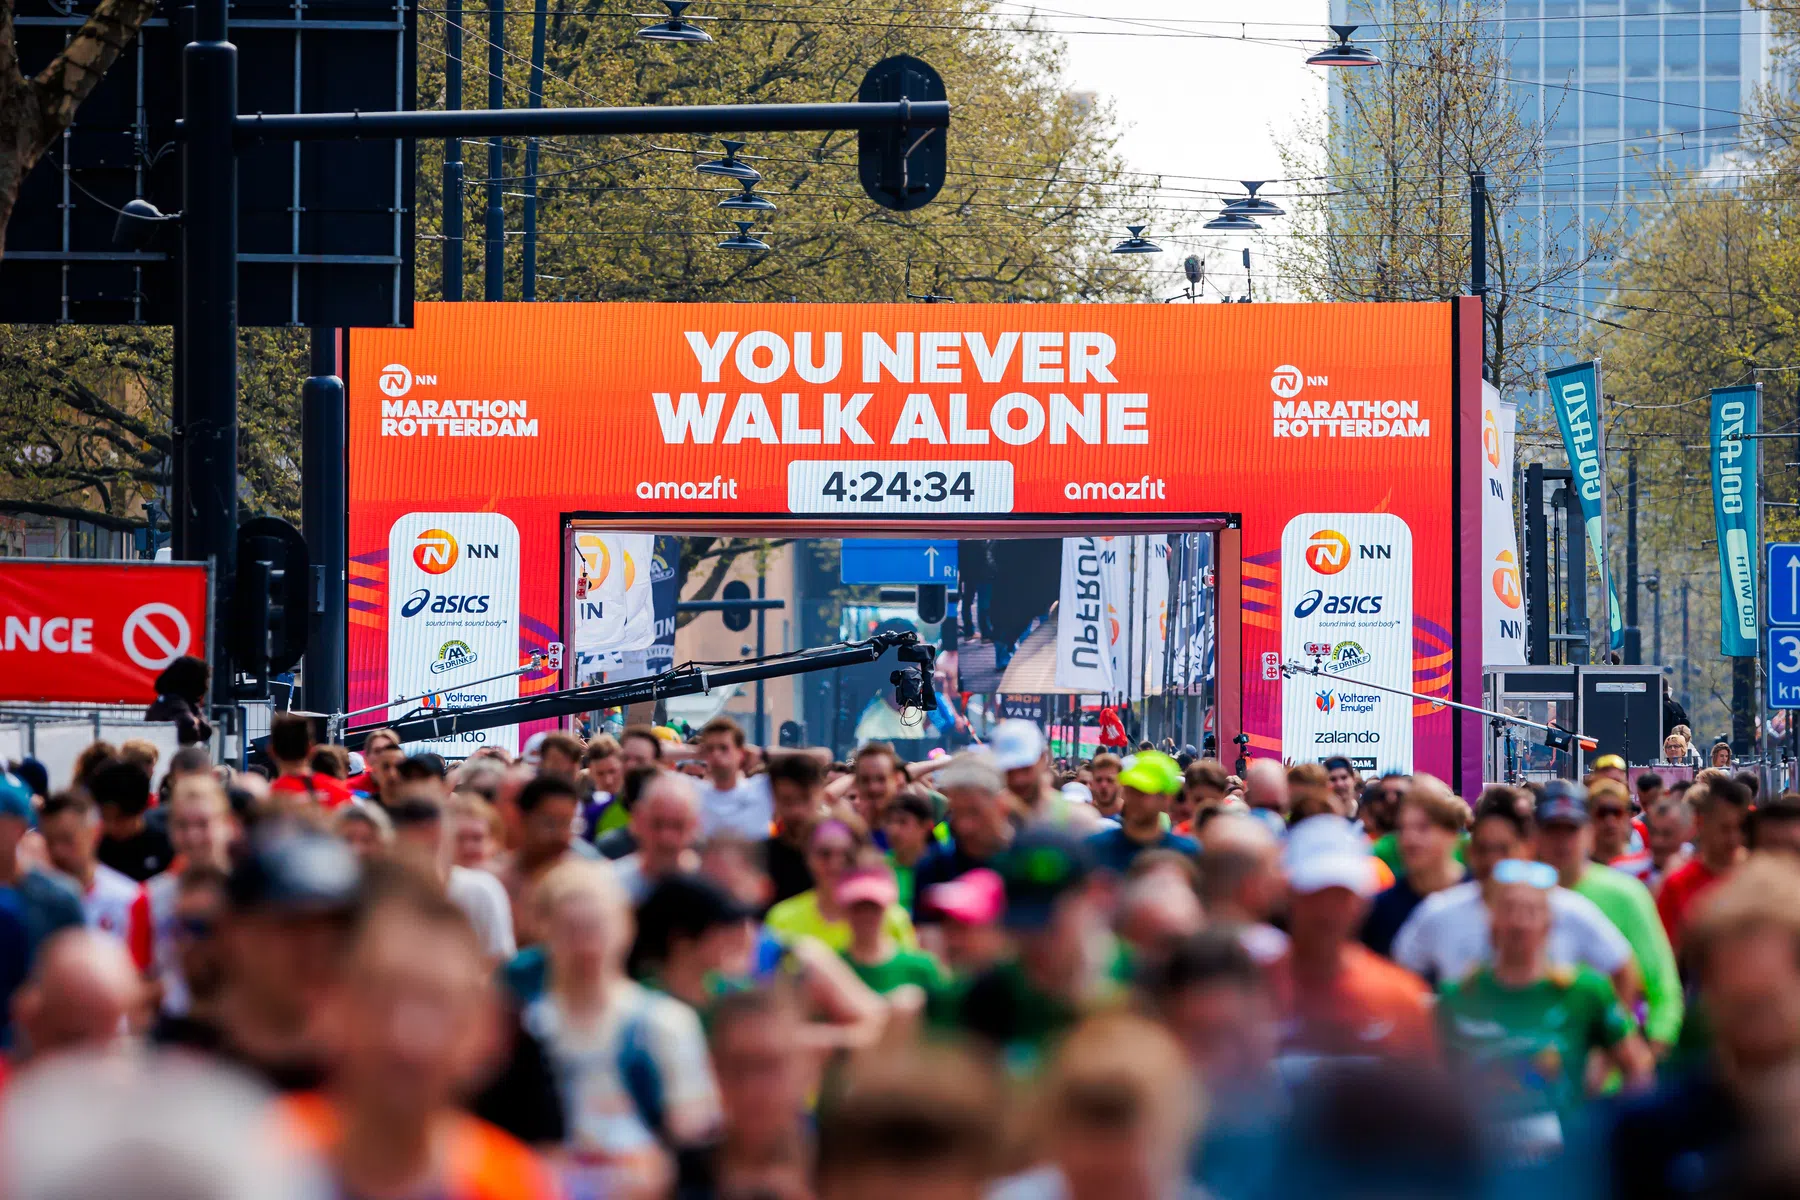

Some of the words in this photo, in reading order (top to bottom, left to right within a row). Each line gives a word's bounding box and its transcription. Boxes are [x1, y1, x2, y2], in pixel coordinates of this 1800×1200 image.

[684, 331, 842, 383] YOU
[863, 332, 1118, 383] NEVER
[415, 375, 437, 386] NN
[1307, 376, 1329, 386] NN
[381, 400, 527, 418] MARATHON
[1273, 401, 1419, 419] MARATHON
[652, 392, 874, 444] WALK
[890, 393, 1149, 445] ALONE
[381, 418, 539, 437] ROTTERDAM
[1273, 419, 1431, 437] ROTTERDAM
[636, 475, 738, 500] amazfit
[822, 470, 975, 502] 4:24:34
[1064, 475, 1166, 500] amazfit
[467, 544, 499, 559] NN
[1359, 544, 1391, 559] NN
[1318, 620, 1339, 628] sound
[1357, 620, 1378, 628] sound
[0, 616, 94, 654] NCE
[448, 647, 465, 660] AA
[1341, 648, 1359, 661] AA
[445, 656, 469, 669] DRINK
[1339, 657, 1362, 670] DRINK
[444, 692, 488, 703] Voltaren
[1337, 692, 1381, 703] Voltaren
[1340, 704, 1374, 714] Emulgel
[1314, 731, 1380, 744] zalando
